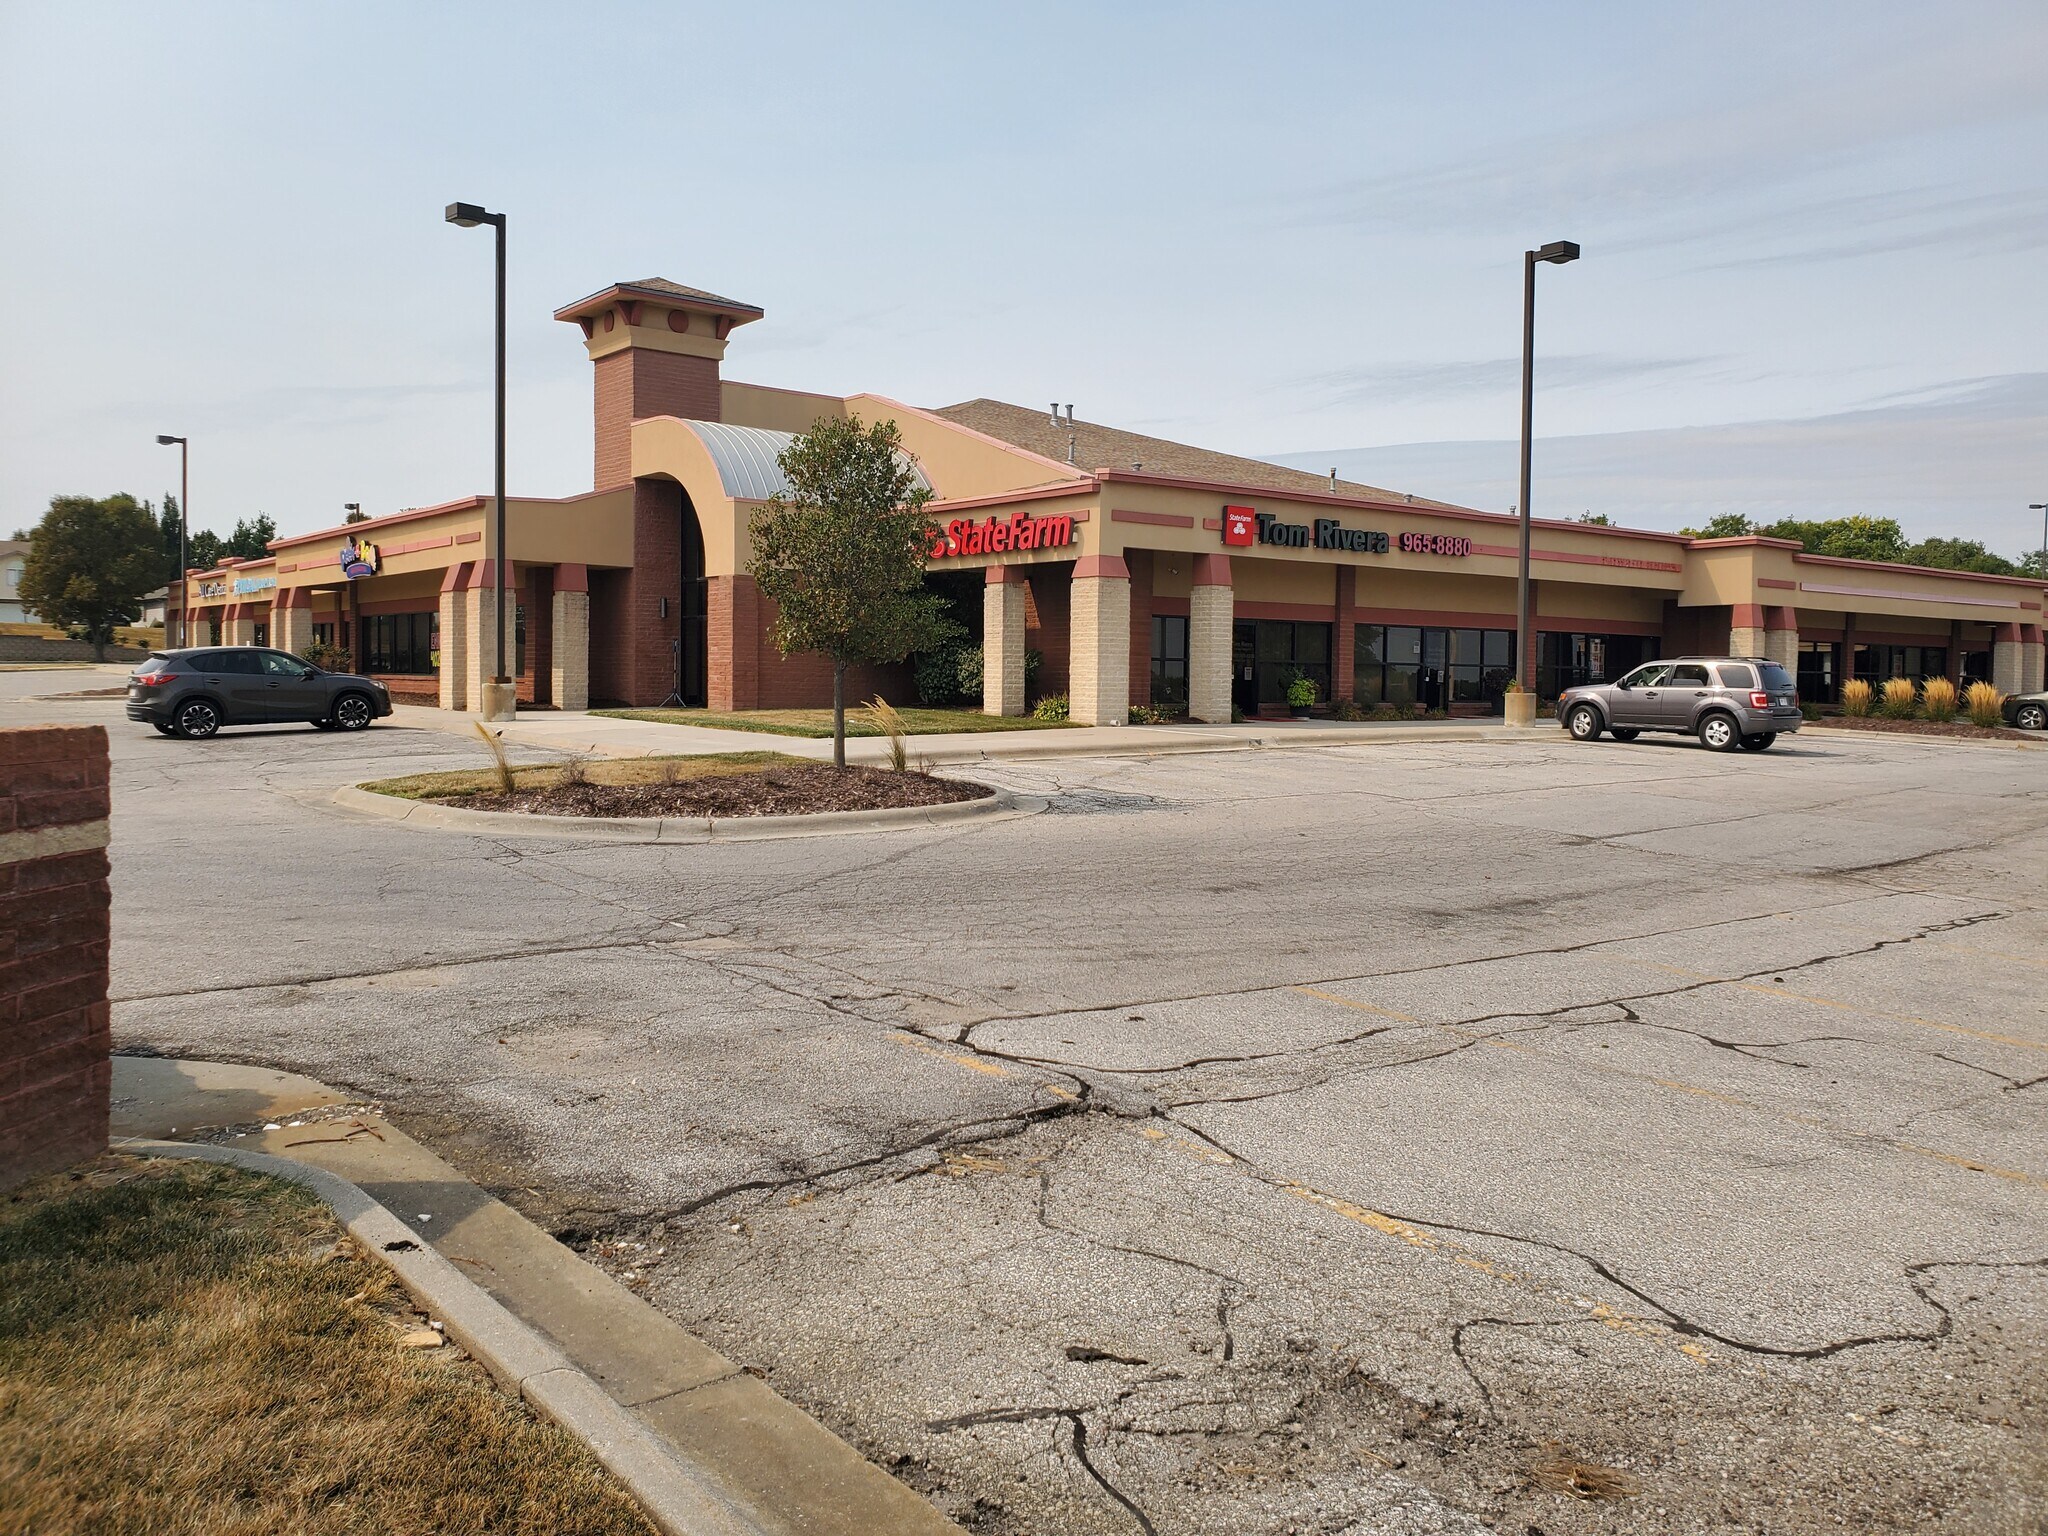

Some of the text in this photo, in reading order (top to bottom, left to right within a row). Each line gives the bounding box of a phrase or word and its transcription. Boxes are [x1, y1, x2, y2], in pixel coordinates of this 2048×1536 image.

[1256, 514, 1472, 557] Tom Rivera 965-8880
